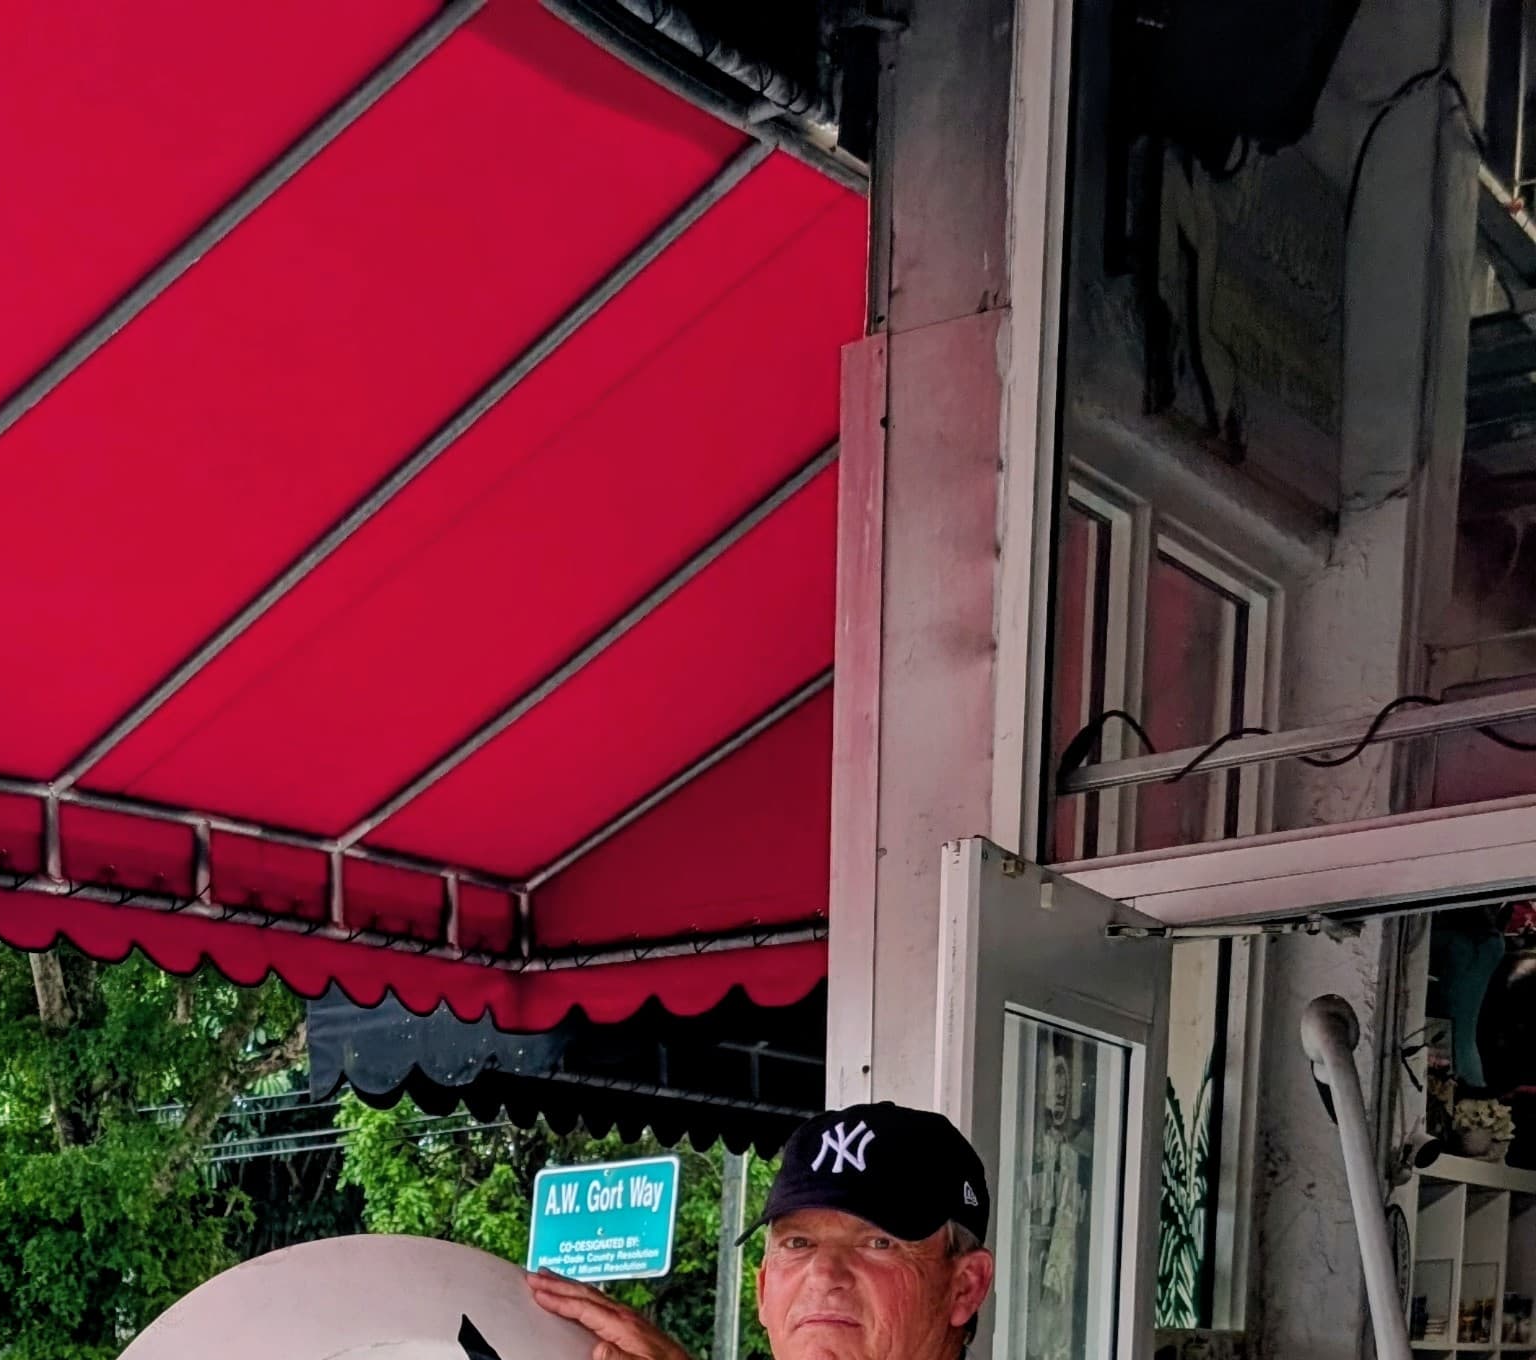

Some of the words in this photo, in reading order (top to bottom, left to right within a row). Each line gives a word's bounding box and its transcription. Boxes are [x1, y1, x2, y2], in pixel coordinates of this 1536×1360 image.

[810, 1120, 876, 1174] NY
[544, 1182, 581, 1216] A.W.
[587, 1179, 623, 1213] Gort
[629, 1175, 664, 1212] Way
[559, 1237, 625, 1253] CO-DESIGNATED
[538, 1253, 585, 1266] Miami-Dade
[586, 1252, 615, 1263] County
[617, 1248, 659, 1260] Resolution
[566, 1264, 577, 1276] of
[578, 1263, 602, 1274] Miami
[604, 1261, 647, 1272] Resolution
